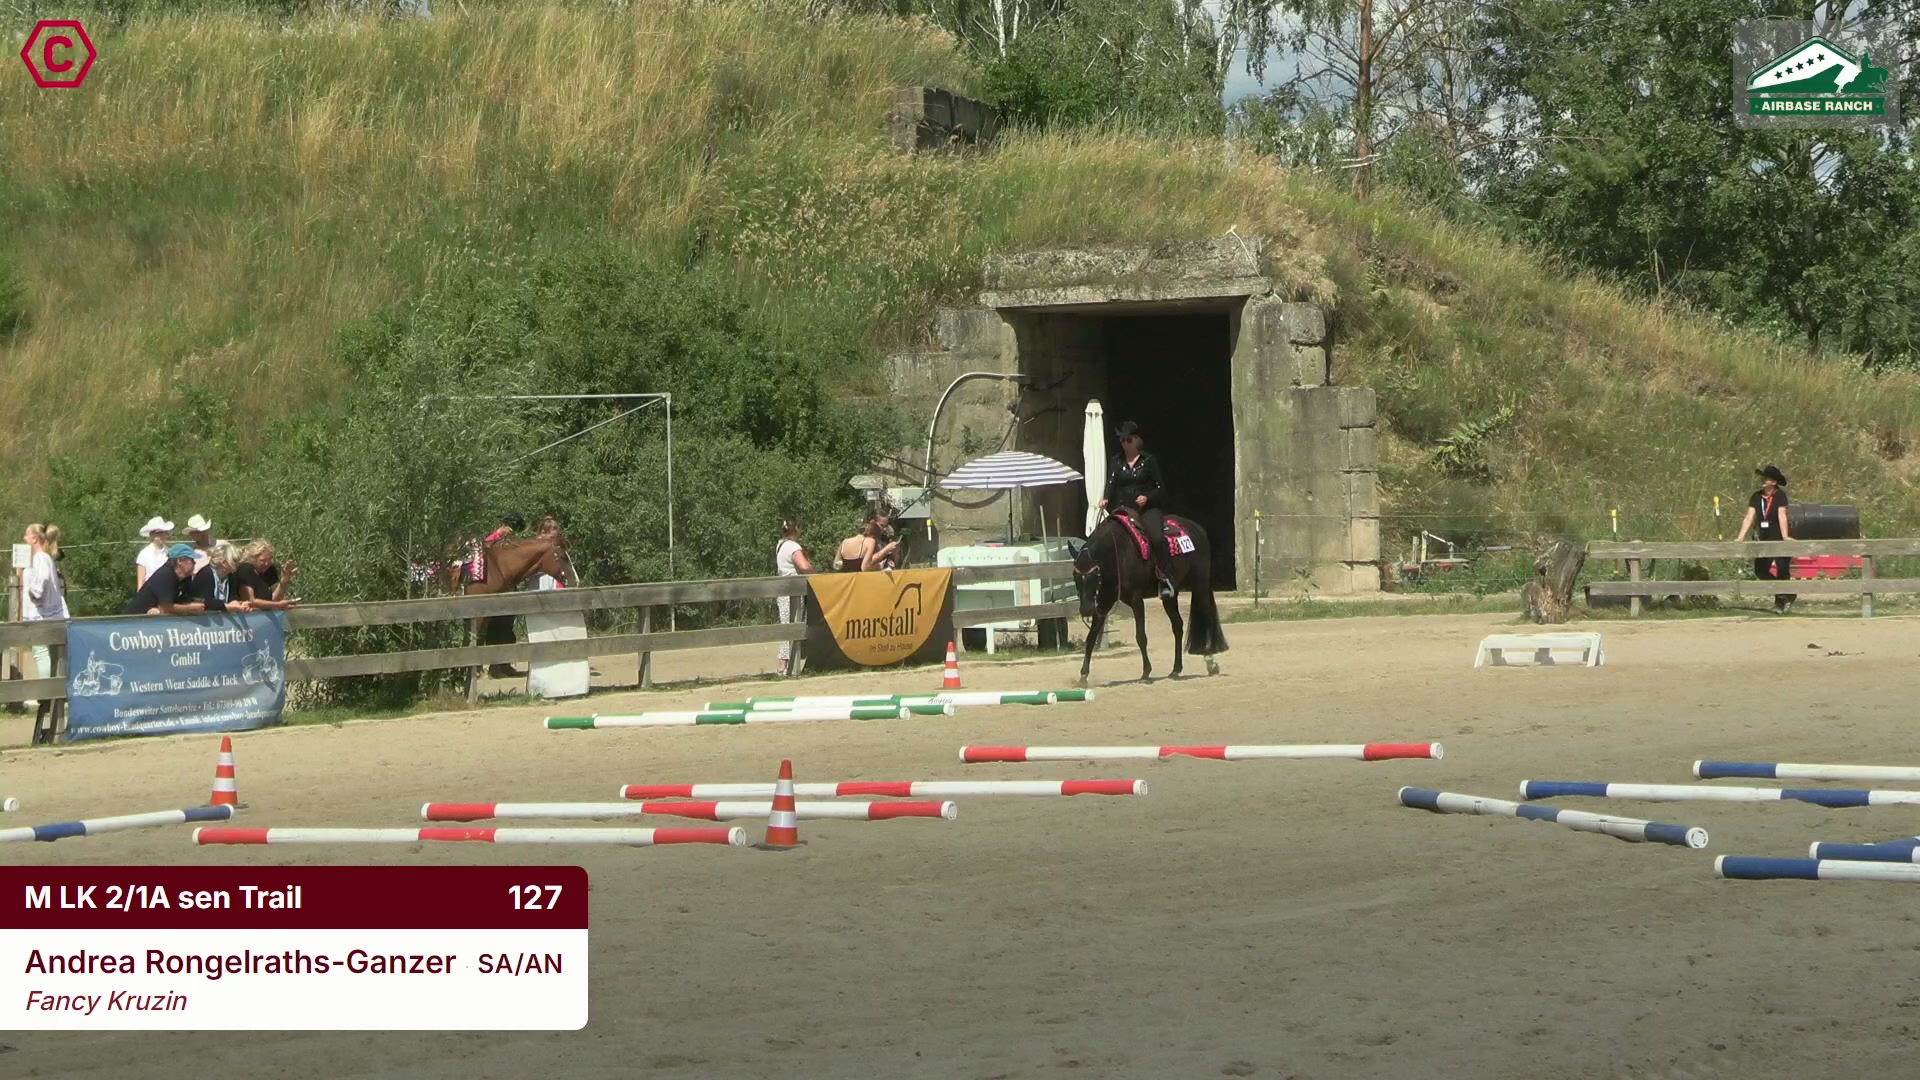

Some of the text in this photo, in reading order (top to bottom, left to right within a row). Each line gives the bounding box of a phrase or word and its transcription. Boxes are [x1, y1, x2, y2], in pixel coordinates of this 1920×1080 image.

[845, 607, 915, 640] marstall
[109, 627, 254, 653] Cowboy Headquarters
[170, 652, 201, 667] GmbH
[129, 674, 238, 694] Western Wear Saddle & Tack
